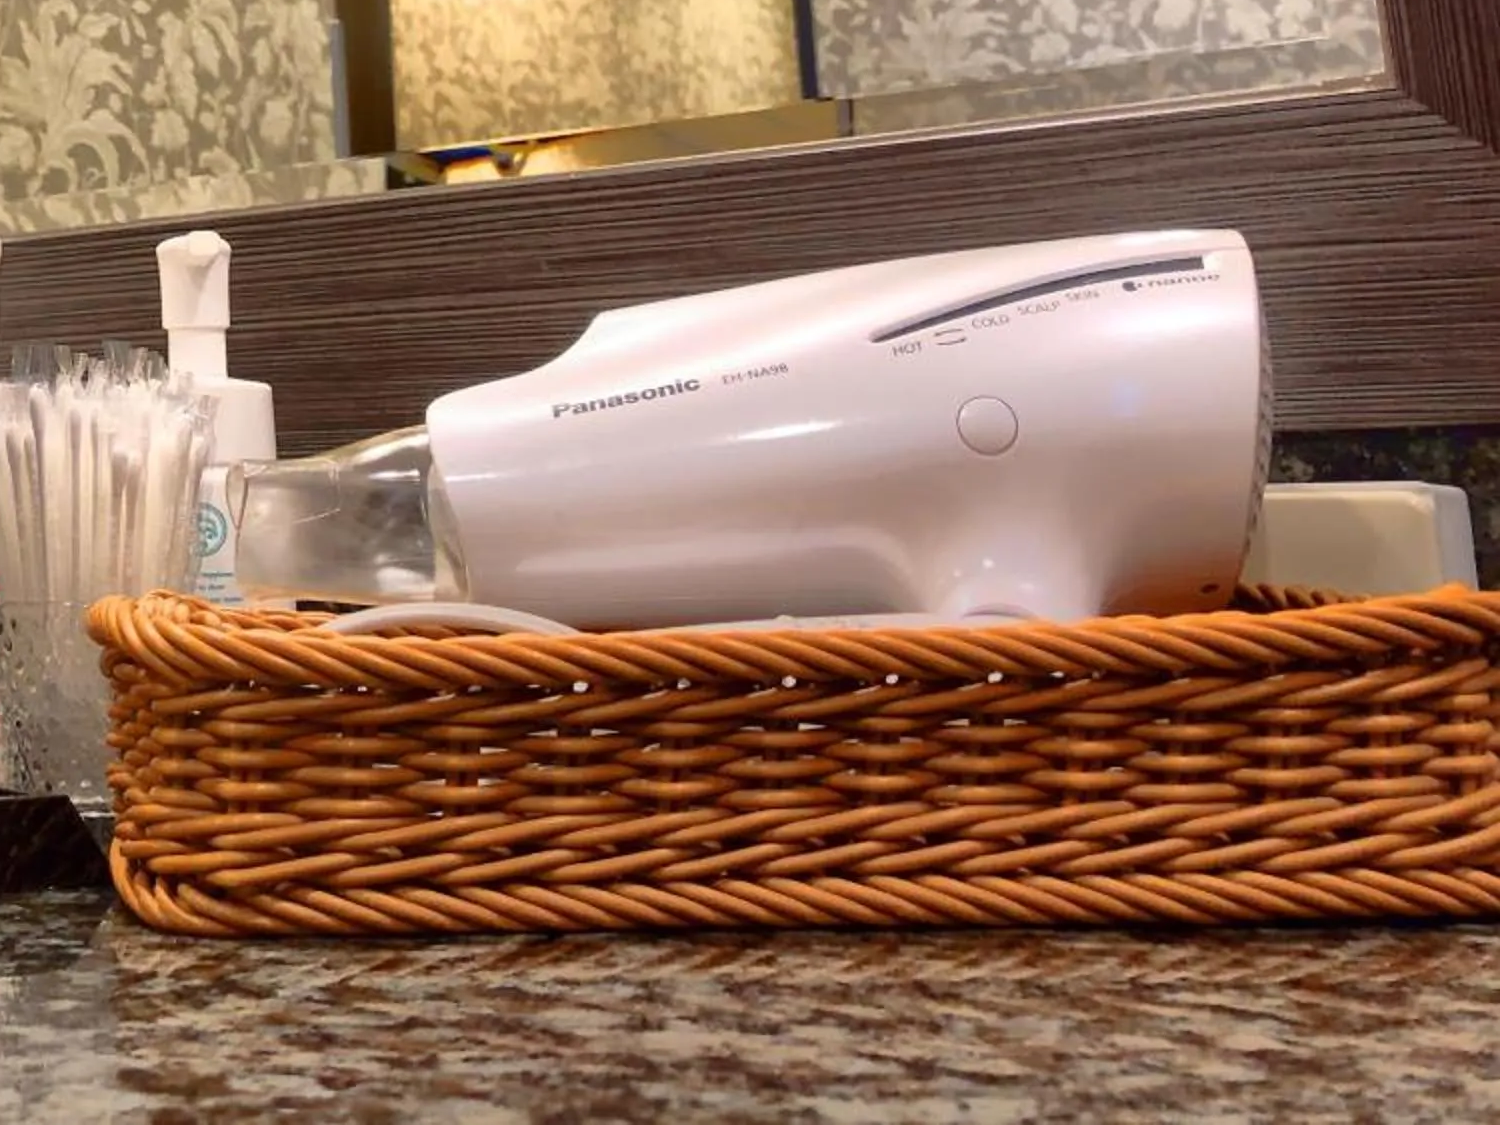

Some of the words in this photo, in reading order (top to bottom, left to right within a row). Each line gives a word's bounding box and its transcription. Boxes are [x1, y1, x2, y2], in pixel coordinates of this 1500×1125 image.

[892, 341, 922, 357] HOT
[971, 314, 1010, 330] COLD
[1017, 300, 1061, 316] SCALP
[1065, 290, 1100, 302] SKIN
[552, 379, 701, 417] Panasonic
